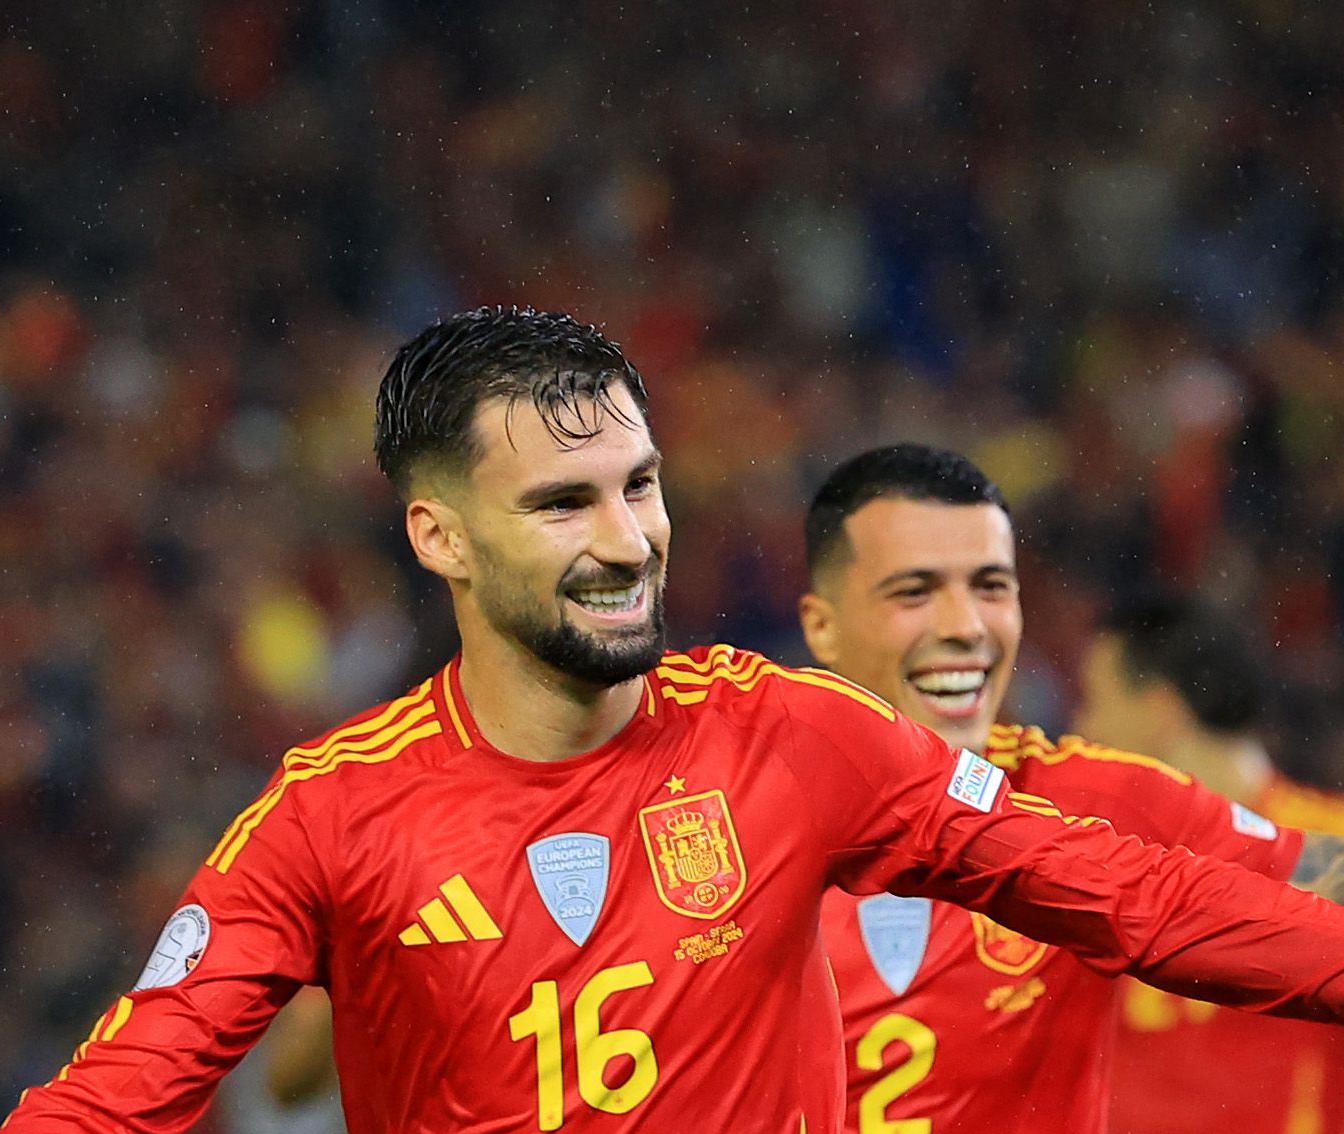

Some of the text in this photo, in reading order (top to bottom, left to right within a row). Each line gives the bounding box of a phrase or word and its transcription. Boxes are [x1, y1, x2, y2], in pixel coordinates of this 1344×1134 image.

[537, 846, 602, 864] EUROPEAN
[538, 857, 603, 874] CHAMPIONS
[559, 904, 594, 918] 2024
[509, 960, 658, 1131] 16
